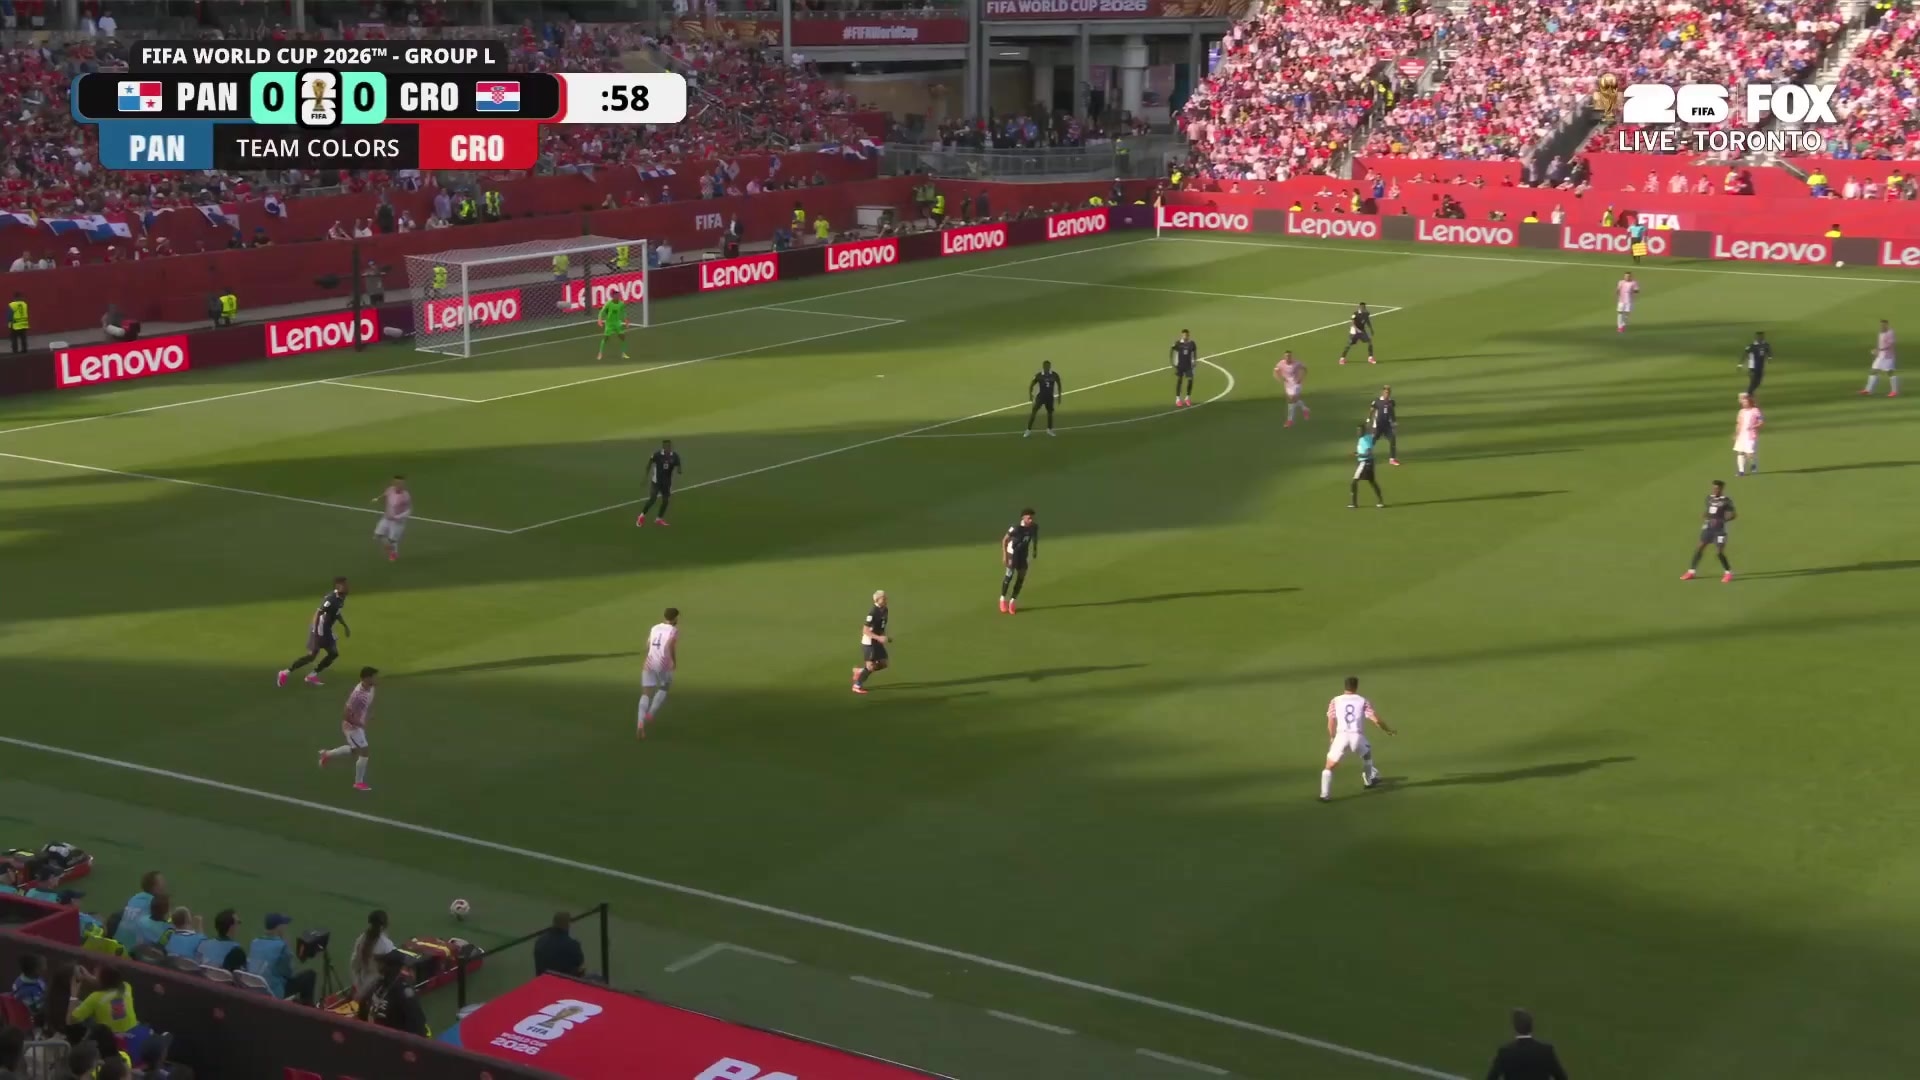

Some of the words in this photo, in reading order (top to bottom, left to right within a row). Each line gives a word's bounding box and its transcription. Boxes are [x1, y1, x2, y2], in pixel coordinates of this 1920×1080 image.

[986, 2, 1016, 14] FIFA
[1019, 1, 1067, 13] WORLD
[1070, 0, 1097, 12] CUP
[1100, 0, 1147, 11] 2026
[696, 213, 723, 230] FIFA
[1049, 214, 1106, 239] Lenovo
[1160, 206, 1249, 231] Lenovo
[1288, 212, 1377, 238] Lenovo
[1638, 213, 1680, 230] FIFA
[944, 229, 1004, 254] Lenovo
[1418, 219, 1513, 245] Lenovo
[1564, 226, 1666, 254] Lenoo
[828, 244, 896, 271] Lenovo
[1715, 234, 1826, 262] Lenovo
[1883, 241, 1920, 265] Le
[702, 260, 775, 289] Lenovo
[427, 298, 517, 331] Lenovo
[270, 317, 374, 354] Lenovo
[61, 345, 184, 385] Lenovo
[652, 633, 662, 650] 4
[1344, 704, 1356, 724] 8
[526, 1025, 549, 1036] FIFA
[490, 1037, 540, 1055] 2026
